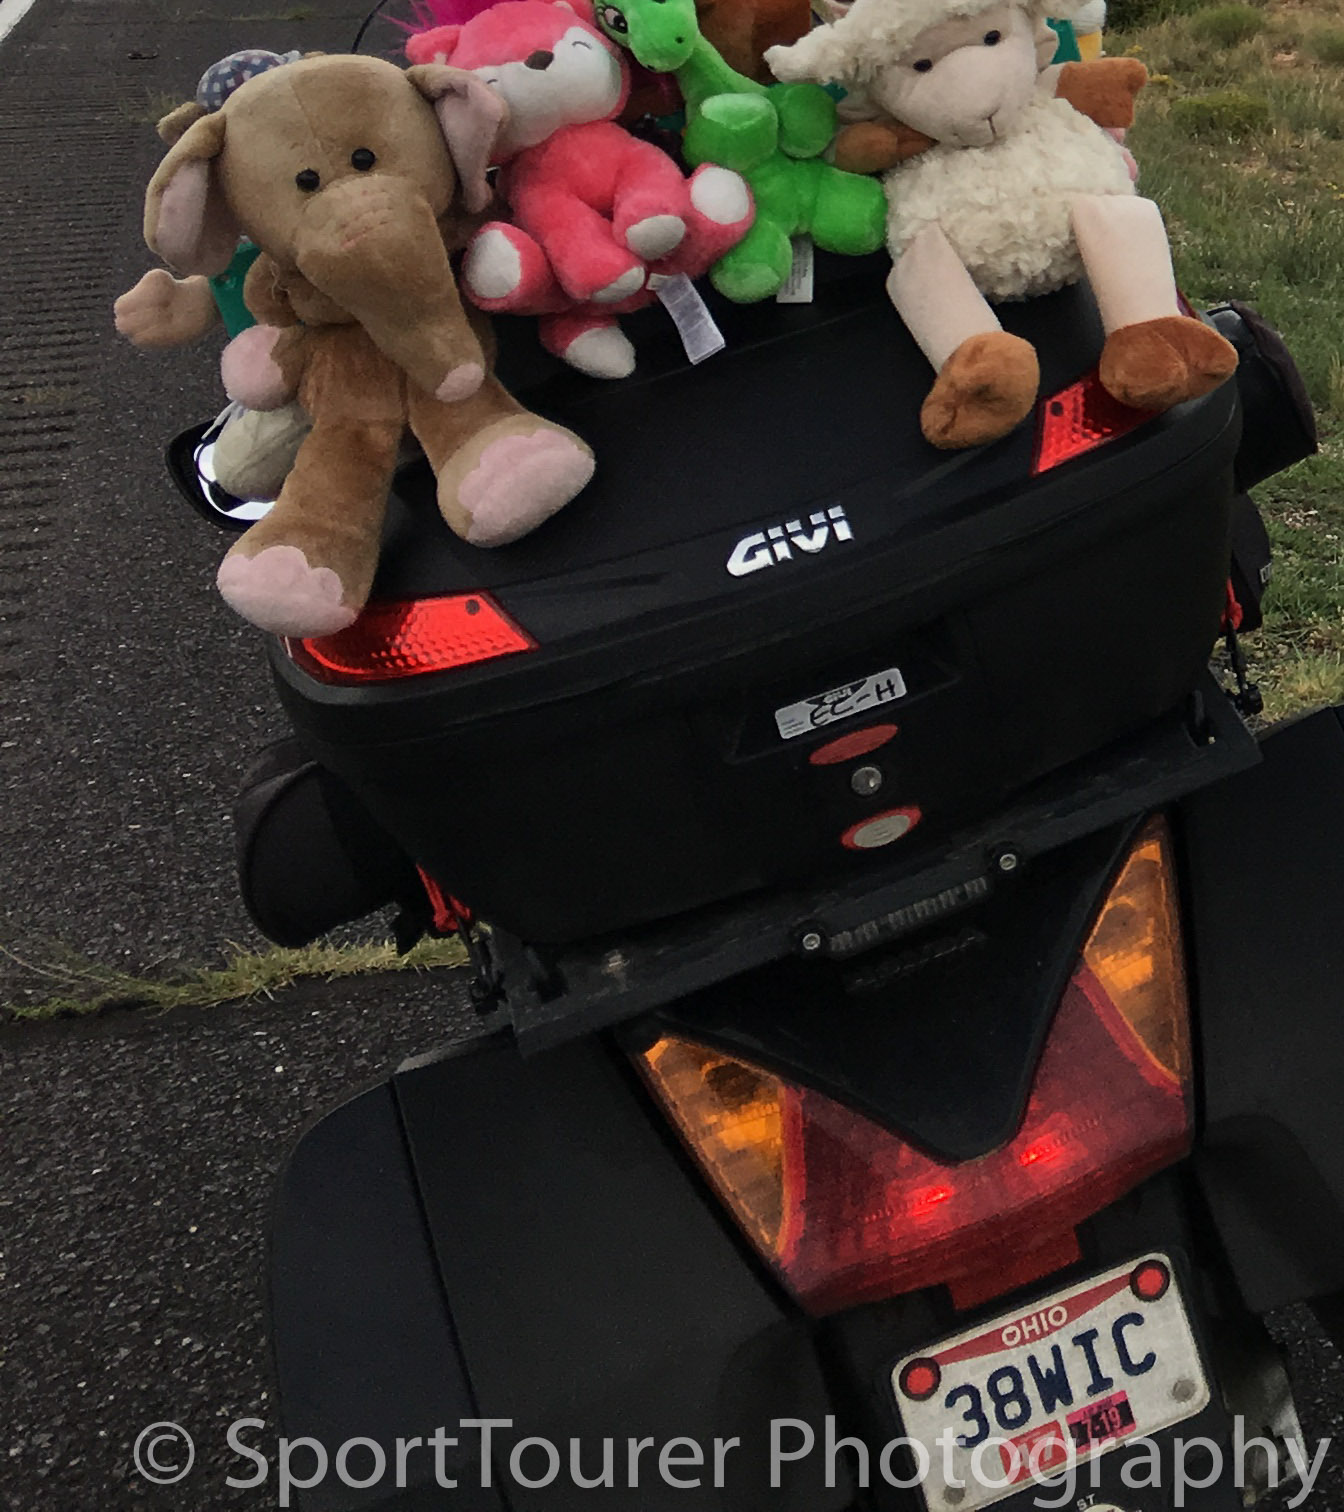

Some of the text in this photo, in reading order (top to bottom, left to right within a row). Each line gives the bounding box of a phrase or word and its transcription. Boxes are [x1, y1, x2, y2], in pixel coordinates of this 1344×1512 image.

[726, 505, 854, 577] GIVI
[1001, 1305, 1068, 1347] OHIO
[944, 1312, 1157, 1449] 38WIC
